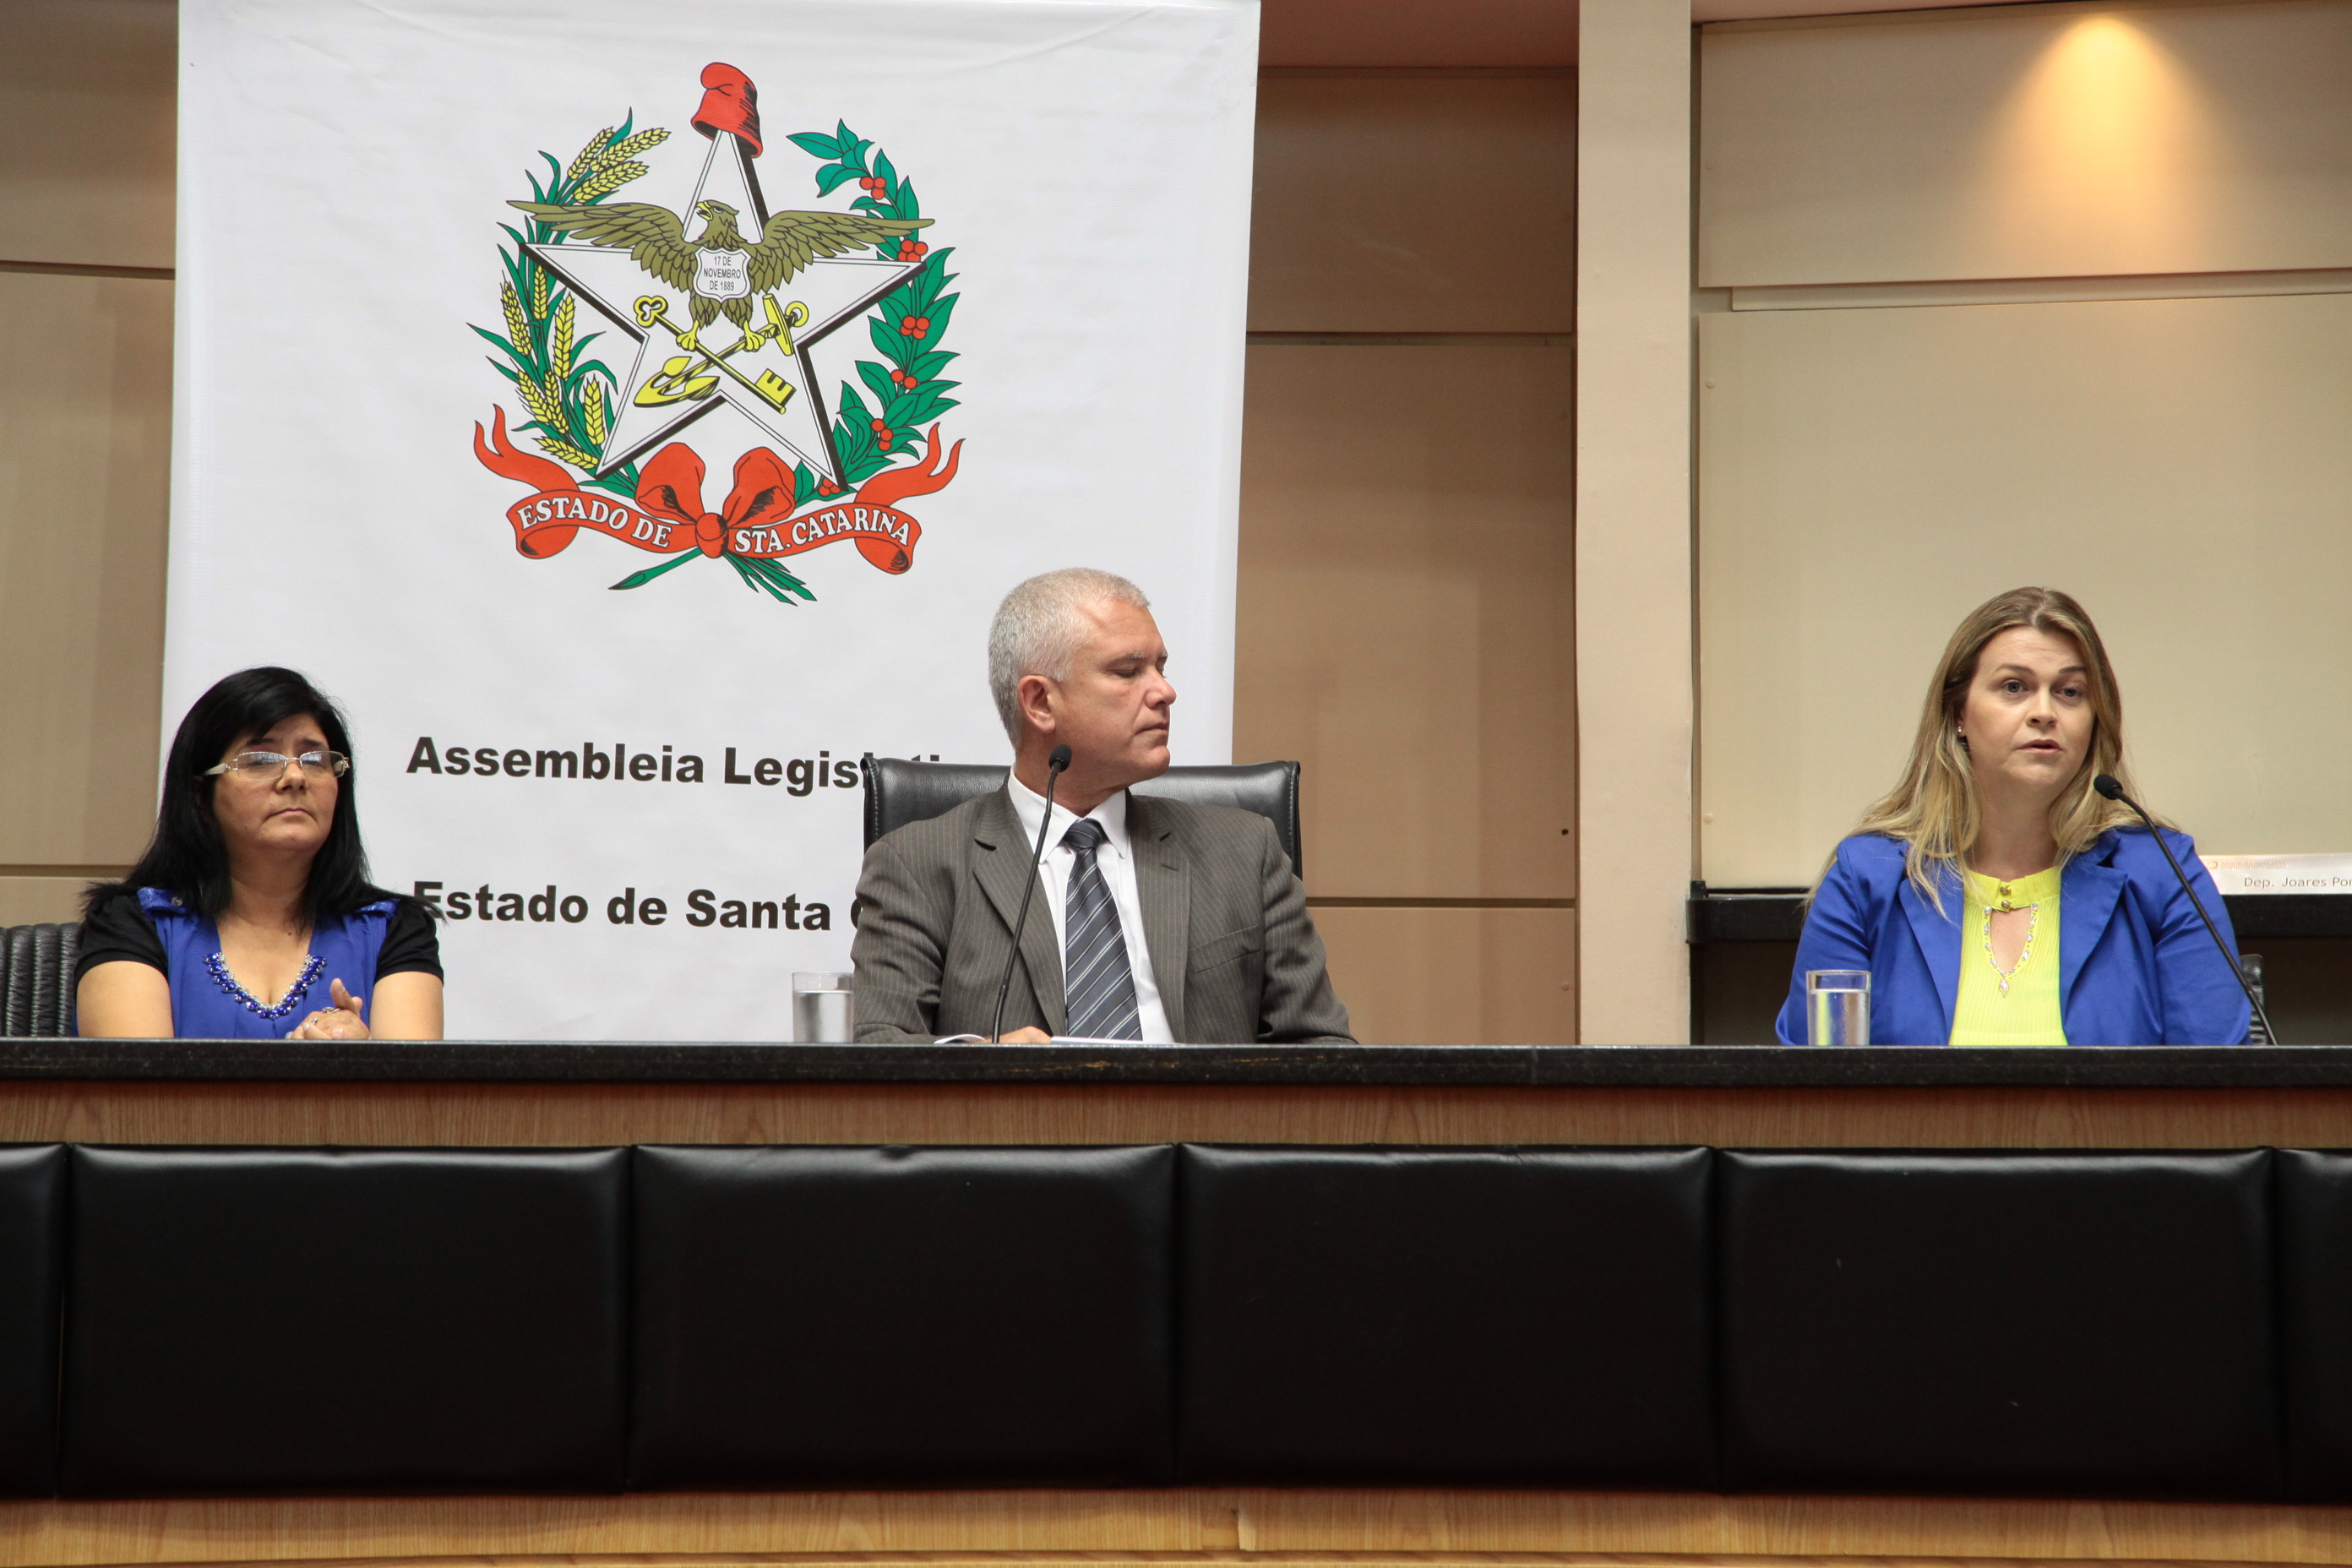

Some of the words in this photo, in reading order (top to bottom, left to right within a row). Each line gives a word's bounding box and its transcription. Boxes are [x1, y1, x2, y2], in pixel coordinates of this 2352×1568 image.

[703, 268, 741, 279] NOVEMBRO
[714, 256, 721, 265] 17
[722, 256, 732, 266] DE
[710, 280, 718, 290] DE
[721, 280, 734, 291] 1889
[516, 497, 629, 531] ESTADO
[631, 517, 672, 548] DE
[734, 528, 792, 553] STA.
[791, 507, 911, 547] CATARINA
[406, 736, 705, 784] Assembleia
[2244, 877, 2275, 889] Dep.
[2282, 877, 2327, 887] Joares
[414, 880, 589, 923] Estado
[607, 887, 668, 926] de
[685, 890, 831, 931] Santa
